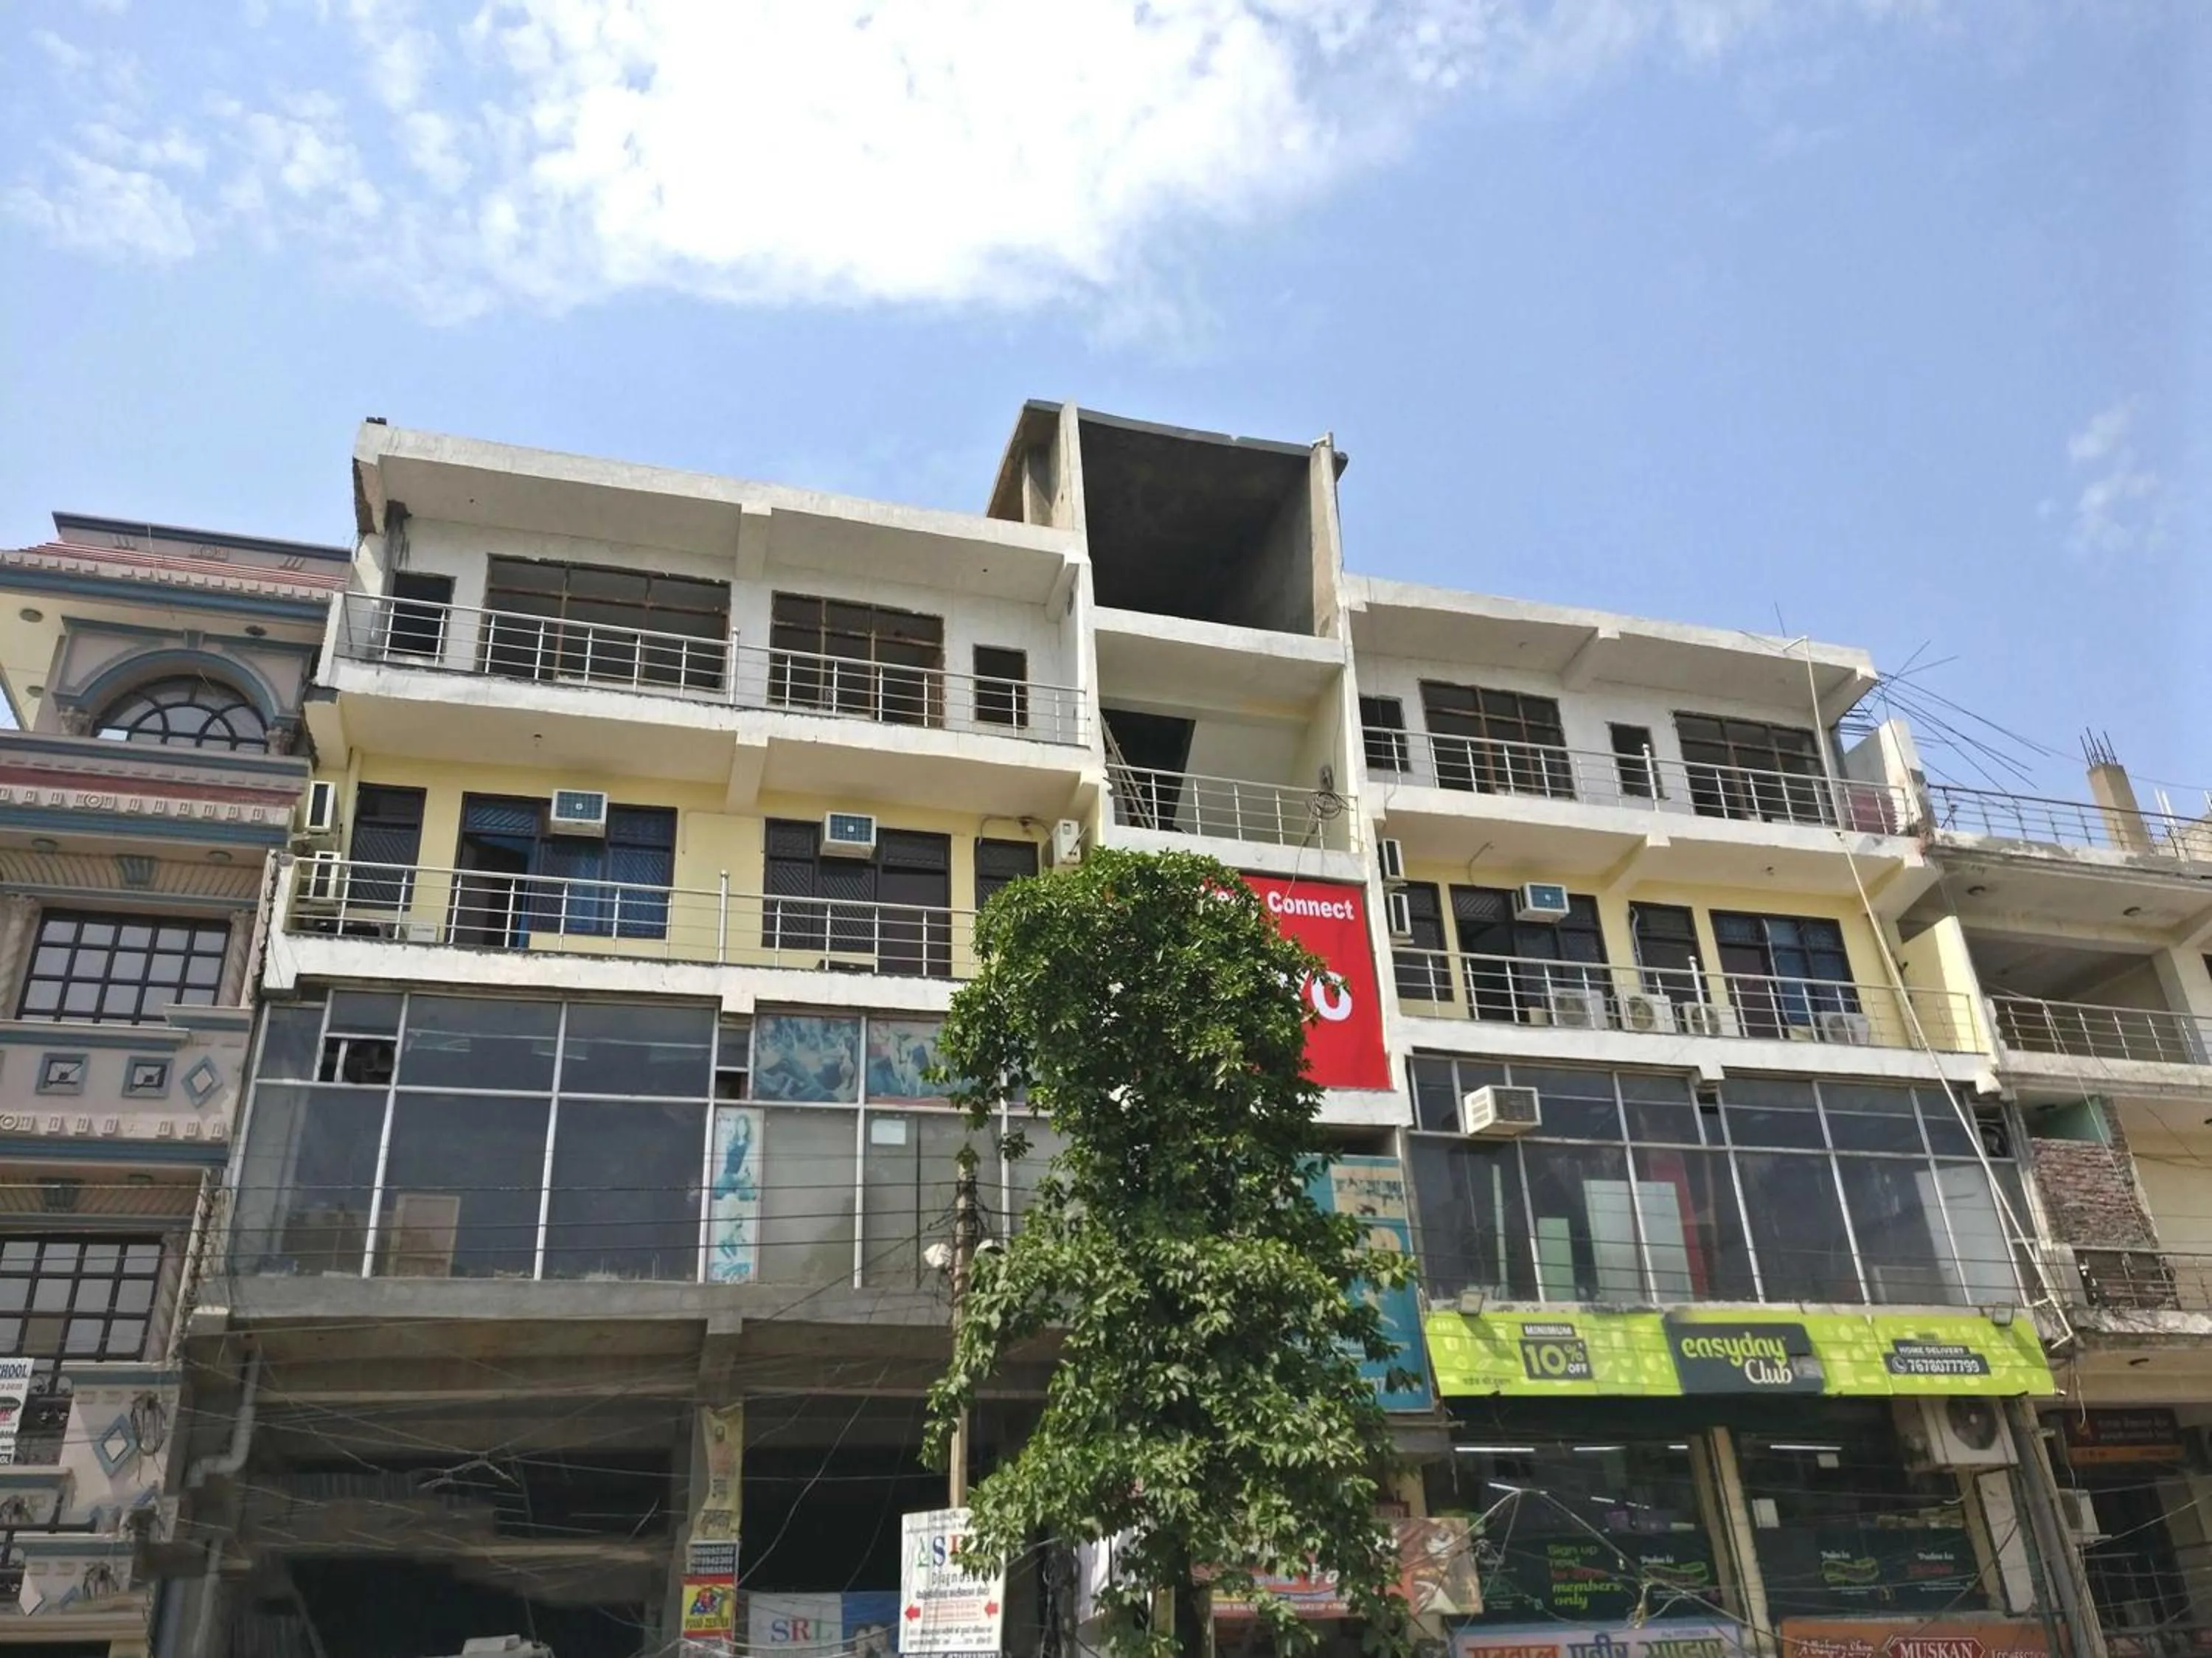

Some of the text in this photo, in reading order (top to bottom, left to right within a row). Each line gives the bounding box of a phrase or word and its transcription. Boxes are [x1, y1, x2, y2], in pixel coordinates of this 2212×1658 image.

[1267, 890, 1354, 920] Connect
[1525, 1325, 1573, 1335] MINIMUM
[1680, 1331, 1787, 1367] easyday
[1898, 1346, 1924, 1354] HOME
[0, 1363, 27, 1378] HOOL
[1568, 1363, 1587, 1374] OFF
[1745, 1359, 1792, 1384] Club
[1552, 1578, 1622, 1593] members
[1554, 1593, 1588, 1609] only
[771, 1617, 832, 1643] SRL
[1899, 1643, 1973, 1658] MUSKAN
